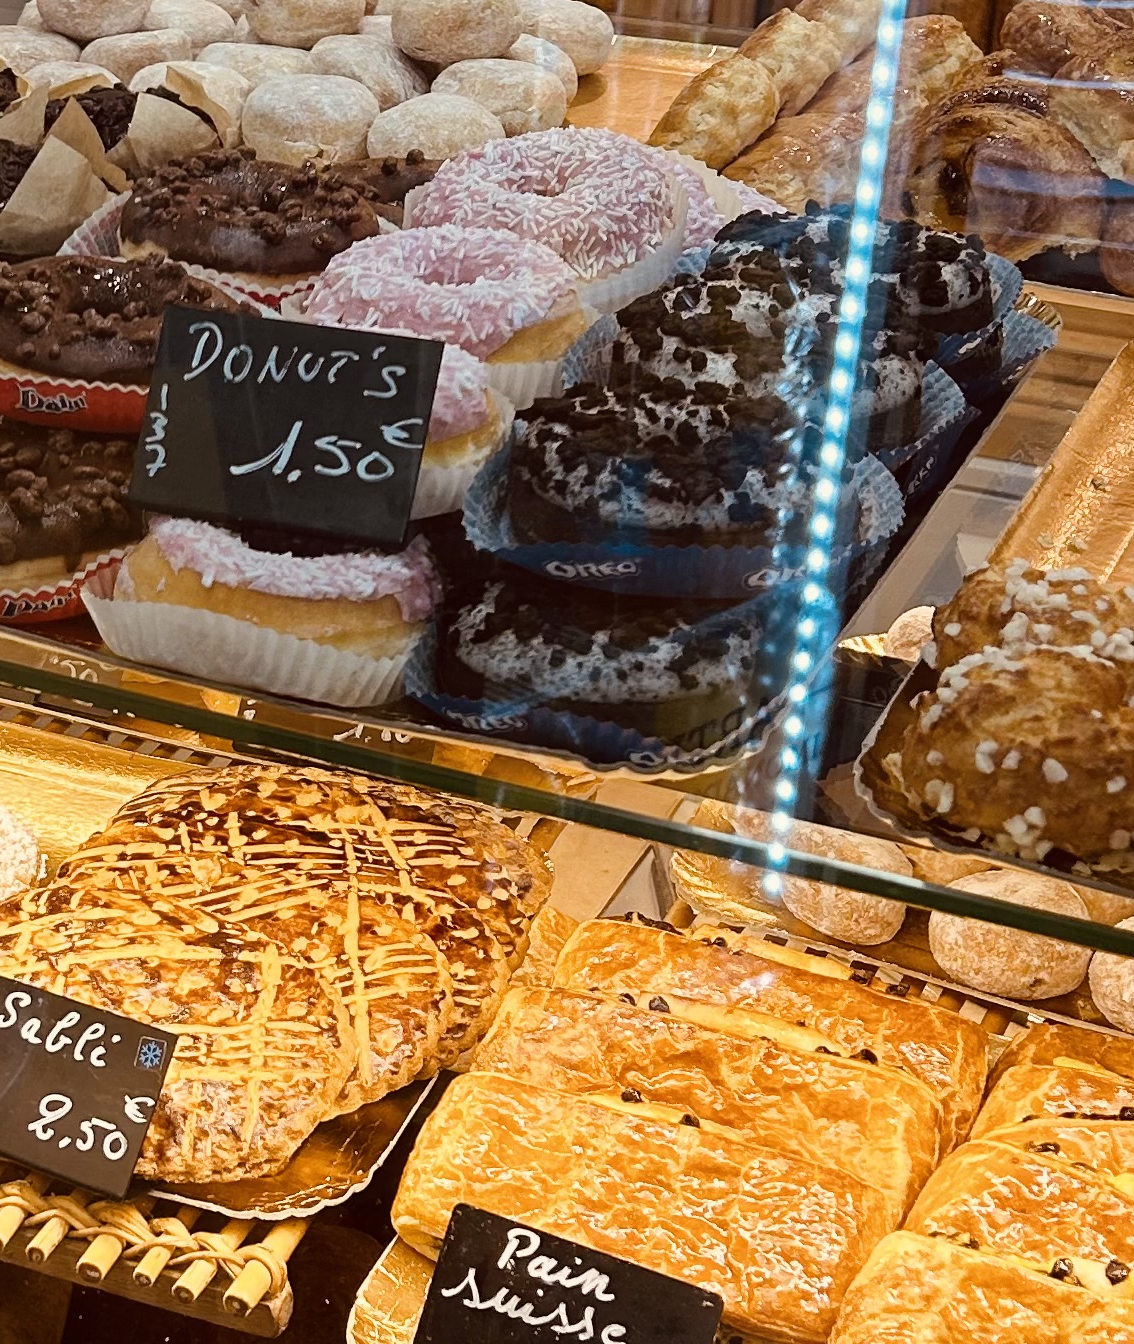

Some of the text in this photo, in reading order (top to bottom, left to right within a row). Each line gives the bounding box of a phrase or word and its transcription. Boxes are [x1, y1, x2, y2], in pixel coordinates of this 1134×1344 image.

[182, 320, 408, 399] DONUT'S
[545, 559, 638, 579] OREO
[496, 1227, 616, 1302] Pain
